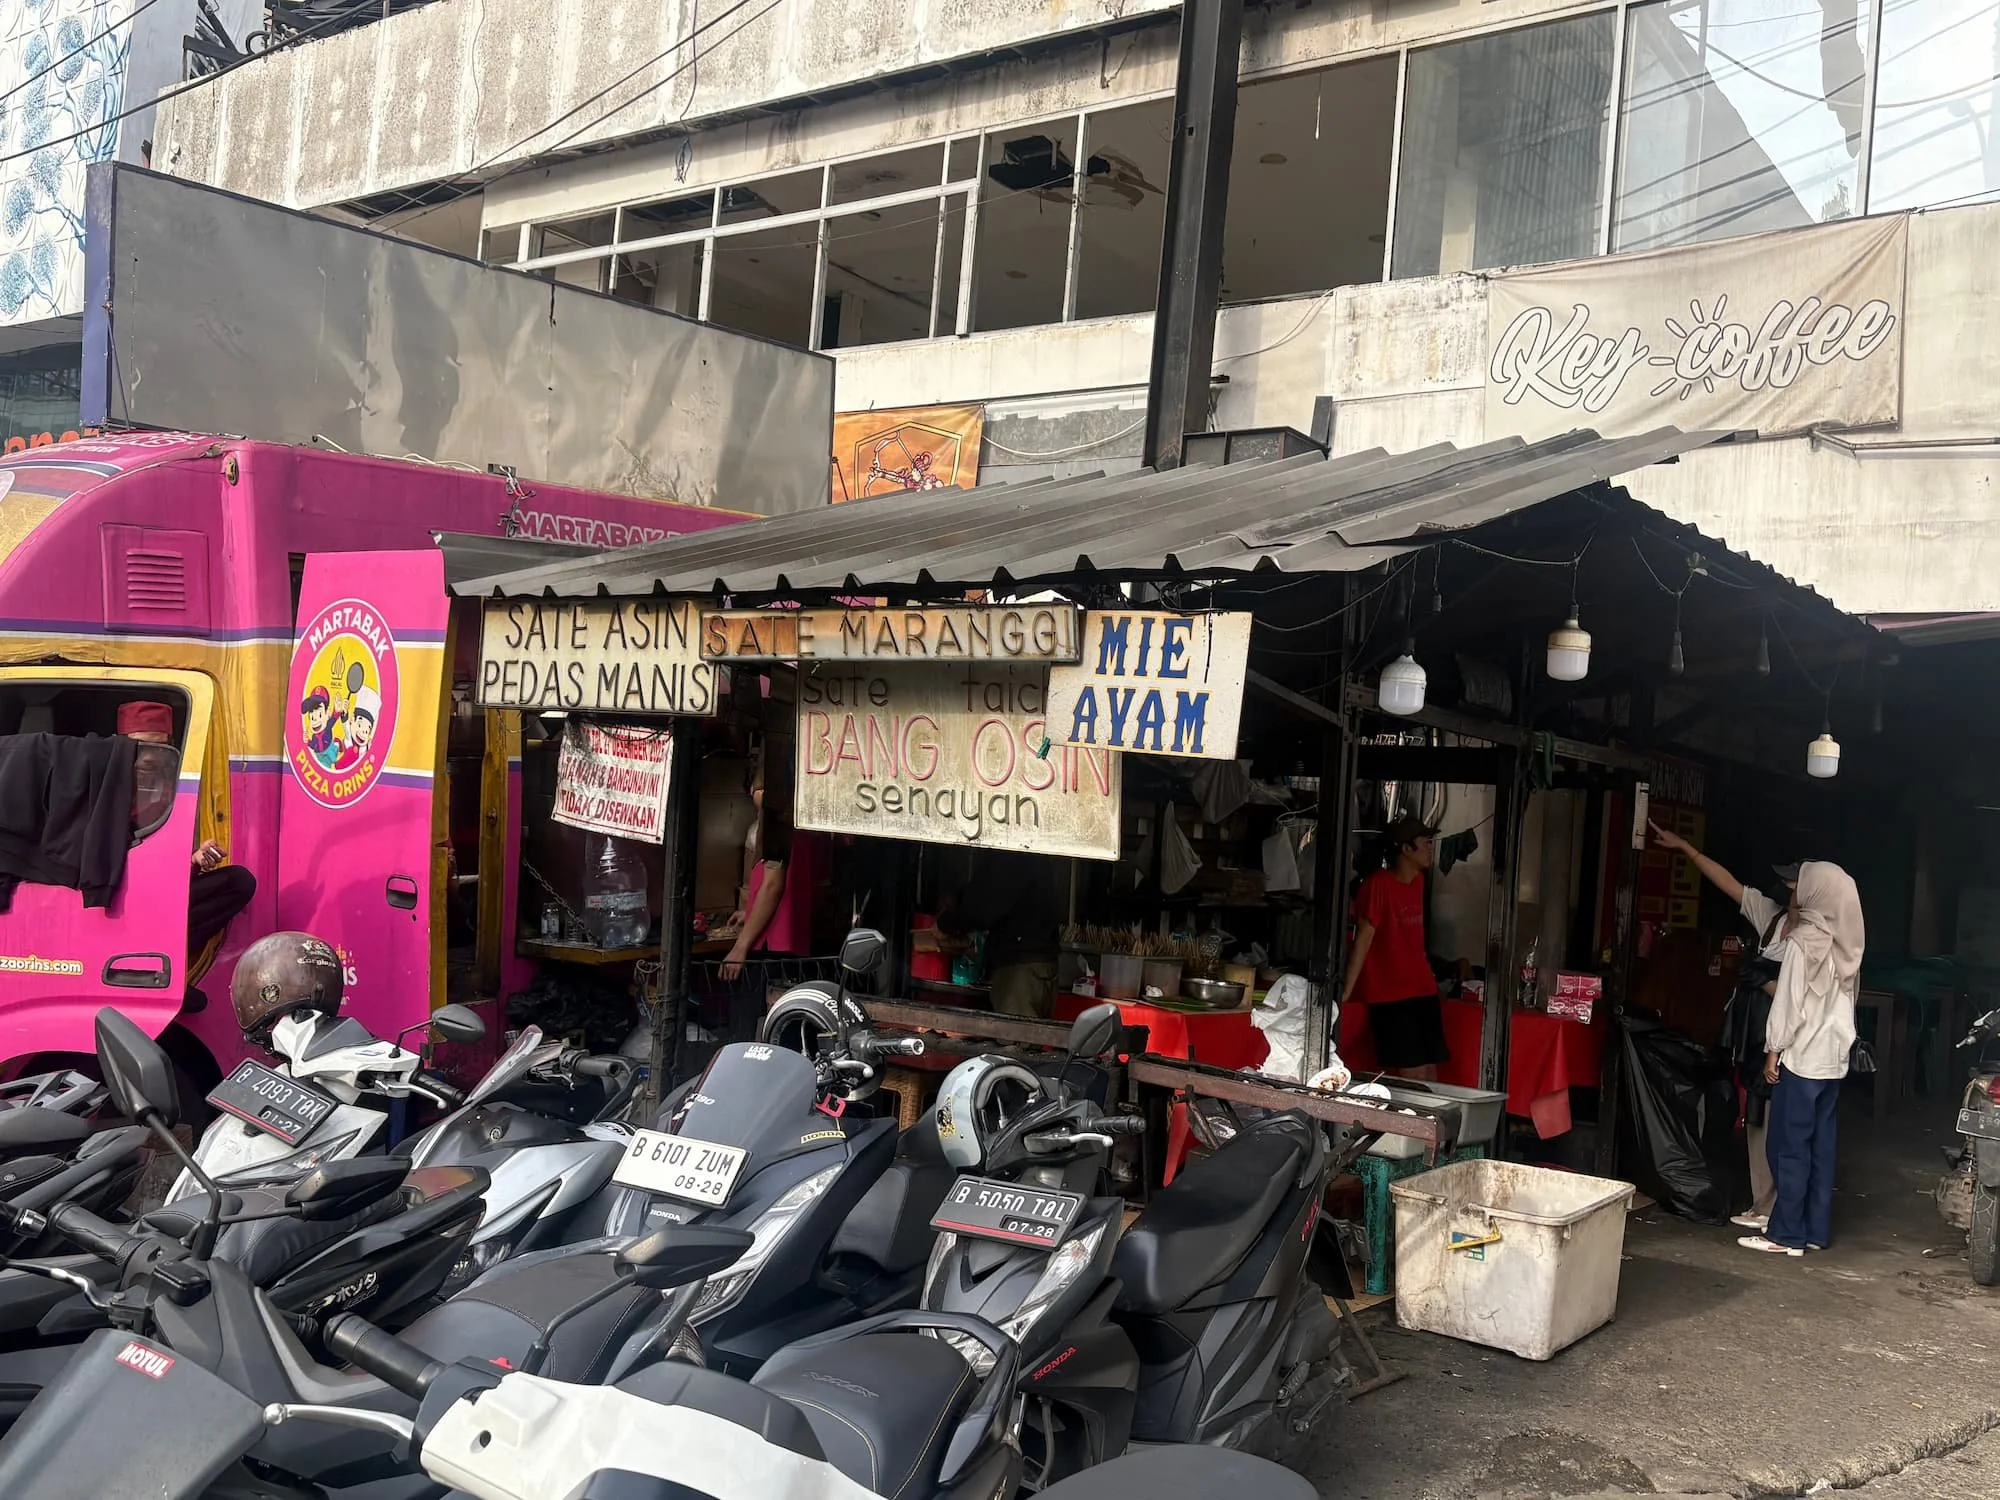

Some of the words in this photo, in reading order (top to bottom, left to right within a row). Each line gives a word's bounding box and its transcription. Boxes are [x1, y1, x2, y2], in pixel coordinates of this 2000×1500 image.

[1490, 303, 1650, 412] Key
[515, 510, 665, 549] MARTABAK
[309, 607, 390, 662] MARTABAK
[505, 602, 588, 650] SATE
[603, 601, 689, 650] ASIN
[705, 614, 816, 656] SATE
[839, 609, 1071, 657] MARANGGI
[1095, 615, 1194, 679] MIE
[482, 659, 584, 707] PEDAS
[596, 661, 711, 712] MANIS
[803, 667, 890, 708] sate
[1067, 685, 1210, 753] AYAM
[805, 709, 939, 781] BANG
[970, 718, 1110, 797] OSIN
[296, 749, 330, 798] PIZZA
[333, 760, 375, 799] ORINS
[561, 789, 593, 817] TIDAK
[594, 798, 657, 830] DISEWAKAN
[855, 782, 1039, 841] senayan
[0, 956, 82, 974] zaorins.com
[236, 1067, 254, 1084] B
[251, 1077, 293, 1104] 4093
[632, 1136, 648, 1157] B
[651, 1141, 692, 1166] 6101
[695, 1149, 735, 1176] ZUM
[803, 1131, 844, 1142] HONDA
[650, 1208, 681, 1222] HONDA
[955, 1186, 971, 1204] B
[975, 1190, 1025, 1212] 5050
[118, 1343, 169, 1377] MOTUL
[1032, 1346, 1077, 1381] HONDA
